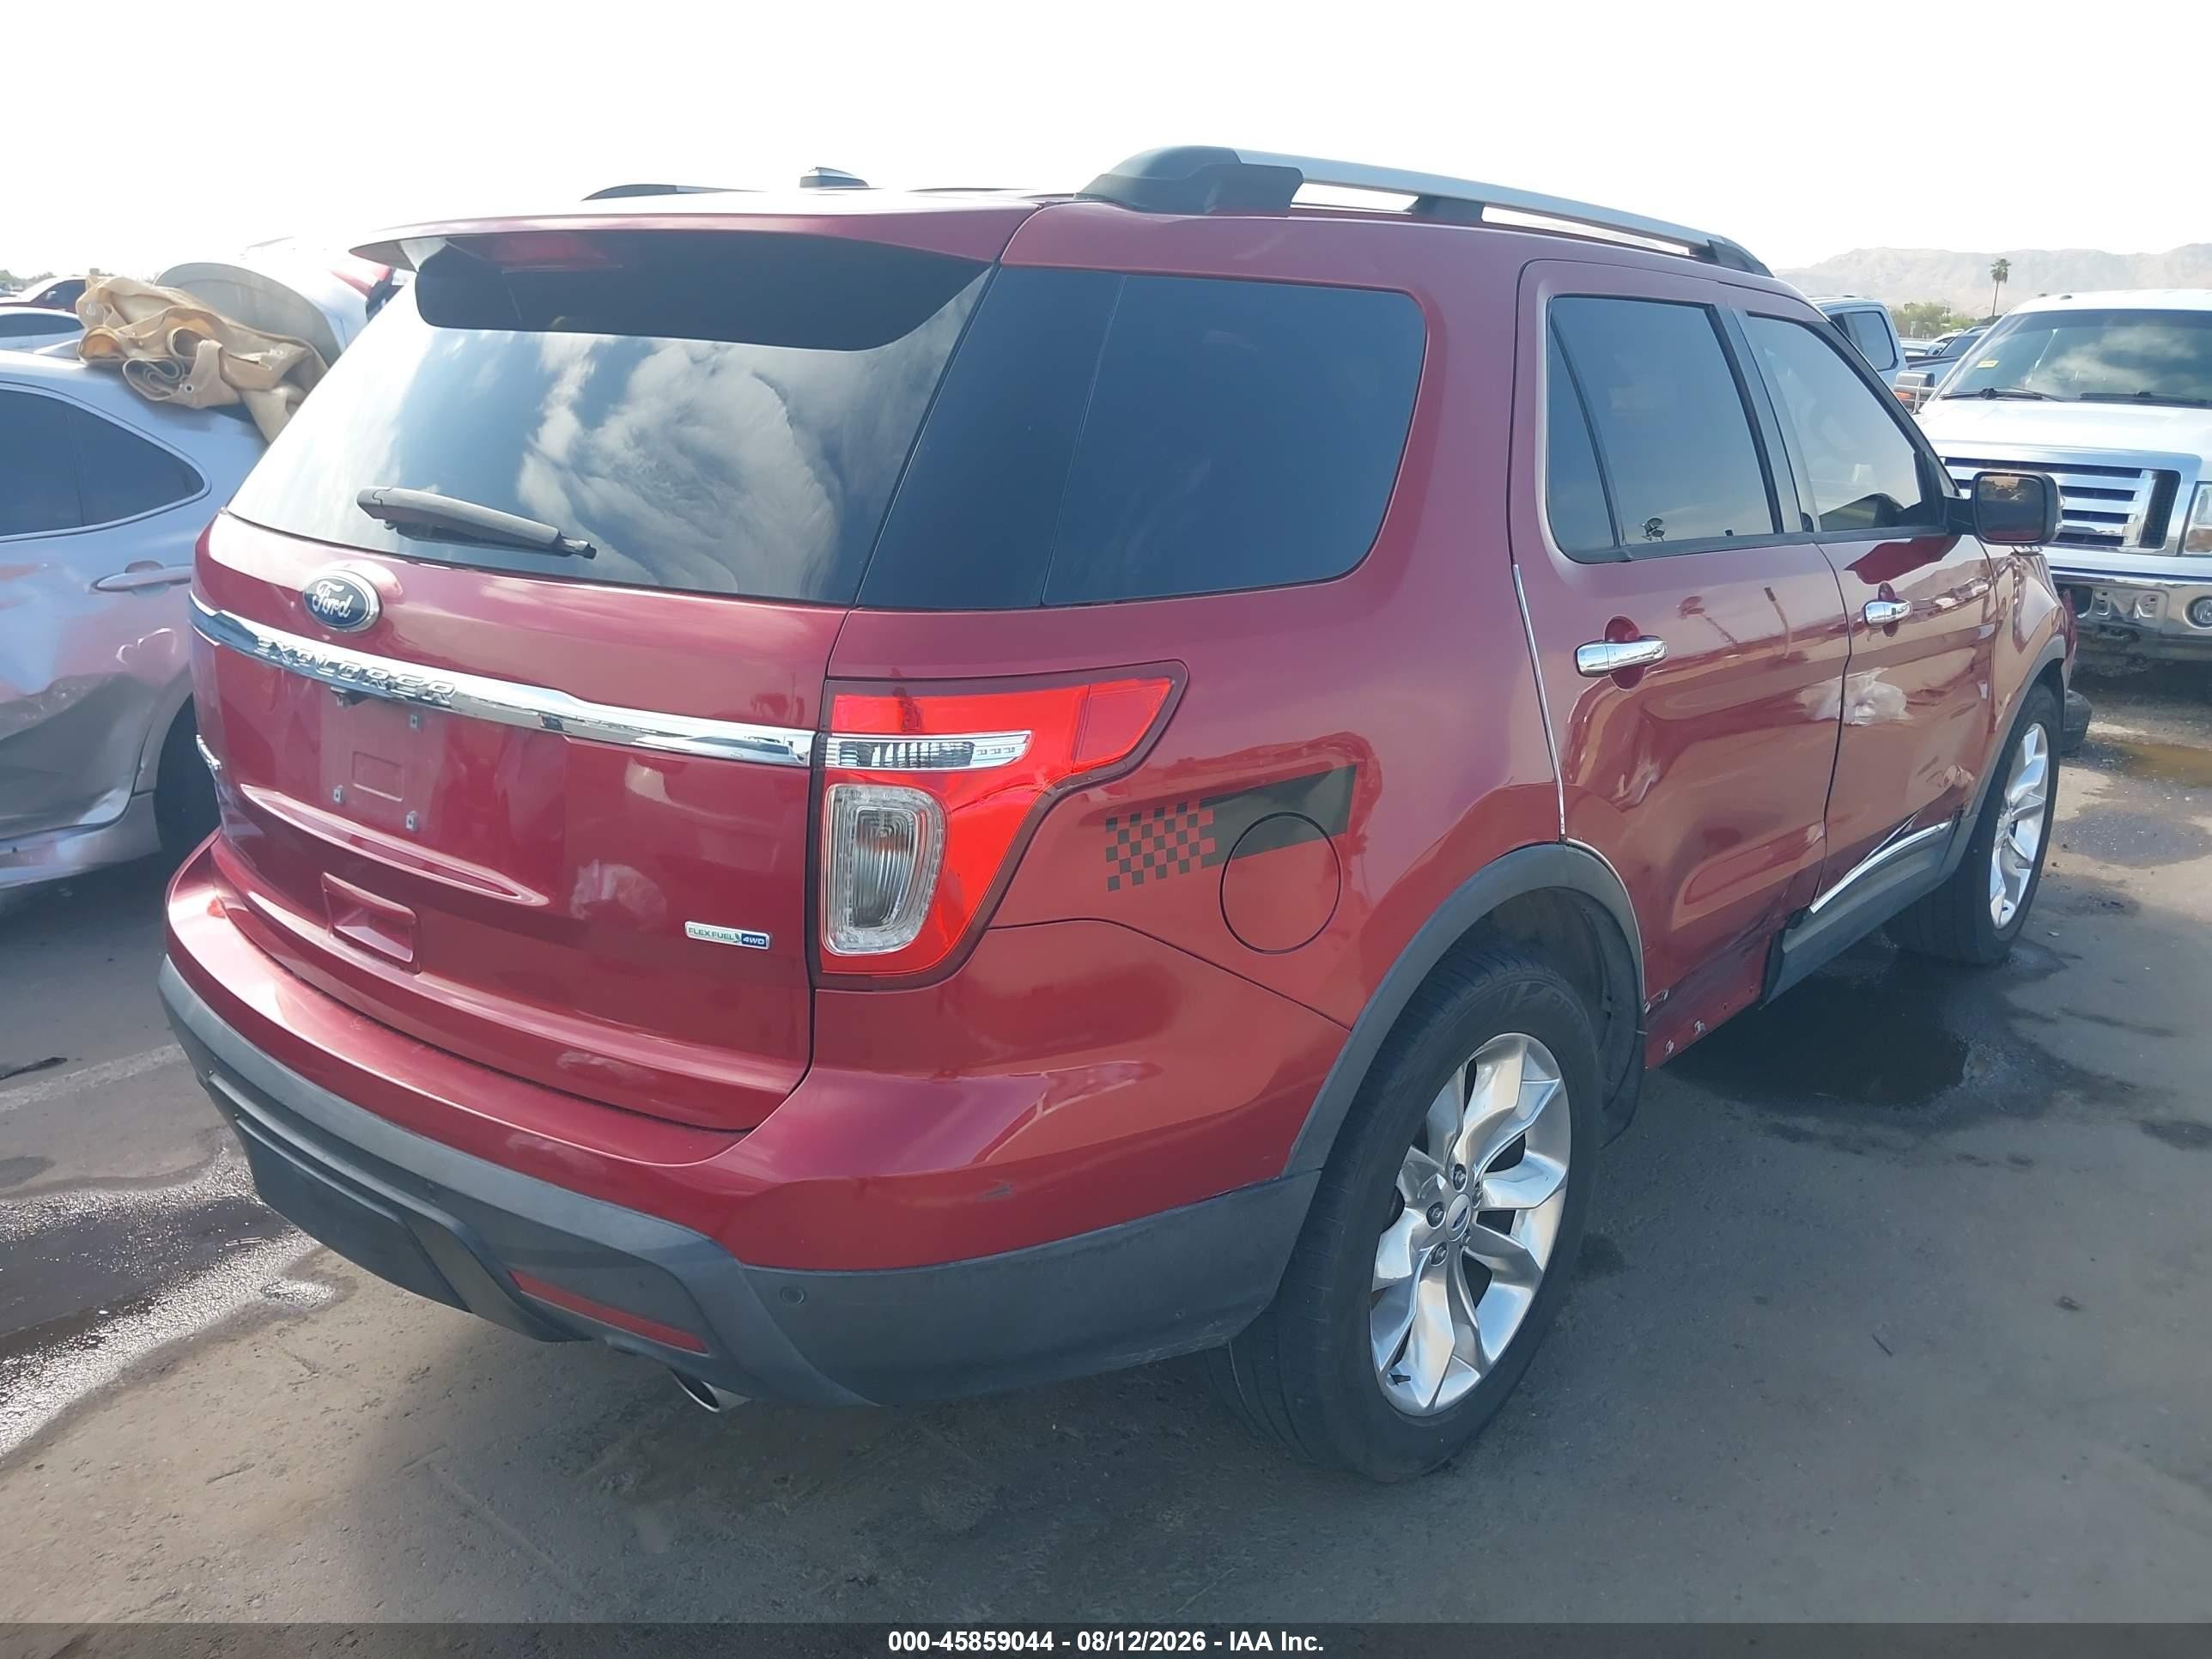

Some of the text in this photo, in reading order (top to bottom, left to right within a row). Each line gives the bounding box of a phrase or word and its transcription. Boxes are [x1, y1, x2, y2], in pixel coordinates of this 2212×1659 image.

[312, 580, 354, 618] Ford
[254, 634, 456, 706] EXPLORER
[688, 927, 765, 945] FLEX FUEL 4WD
